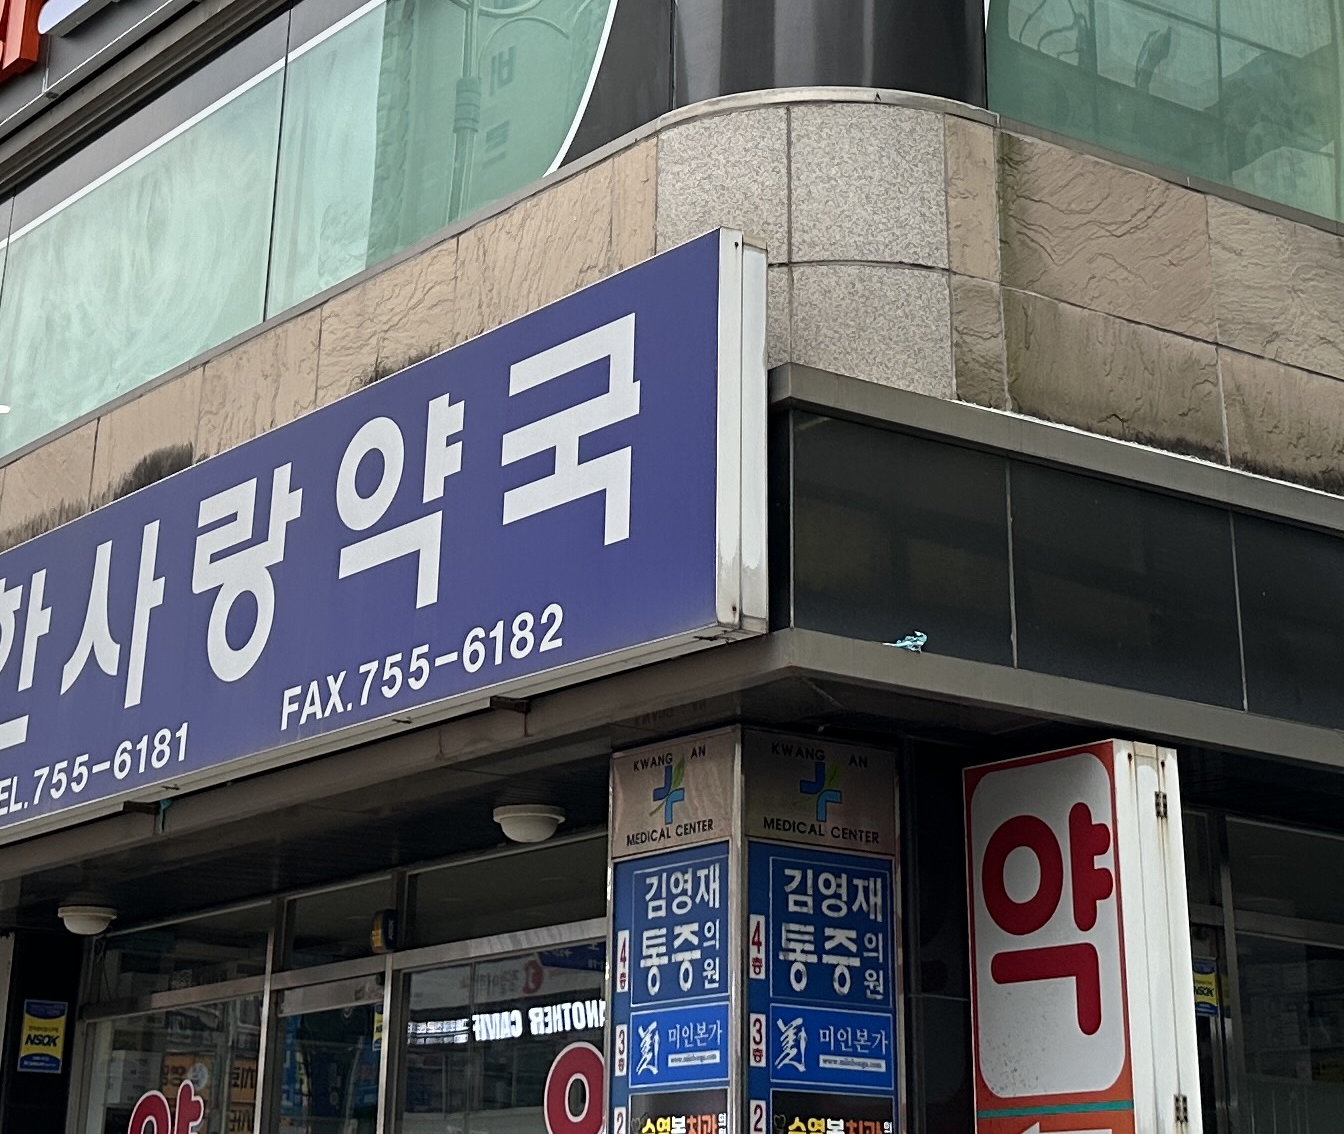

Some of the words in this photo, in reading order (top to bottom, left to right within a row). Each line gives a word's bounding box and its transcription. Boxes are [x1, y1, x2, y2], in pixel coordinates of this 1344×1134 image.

[633, 752, 674, 771] KWANG
[690, 745, 706, 760] AN
[772, 742, 826, 761] KWANG
[848, 754, 869, 768] AN
[626, 826, 672, 847] MEDICAL
[675, 818, 714, 837] CENTER
[763, 817, 825, 837] MEDICAL
[830, 825, 880, 845] CENTER
[644, 863, 721, 920] 김영재
[783, 868, 883, 922] 김영재
[982, 801, 1114, 1036] 약
[640, 921, 702, 997] 통증
[779, 922, 861, 996] 통증
[25, 1034, 60, 1047] NSOK
[668, 1019, 723, 1049] 미인본가
[819, 1025, 889, 1055] 미인본가
